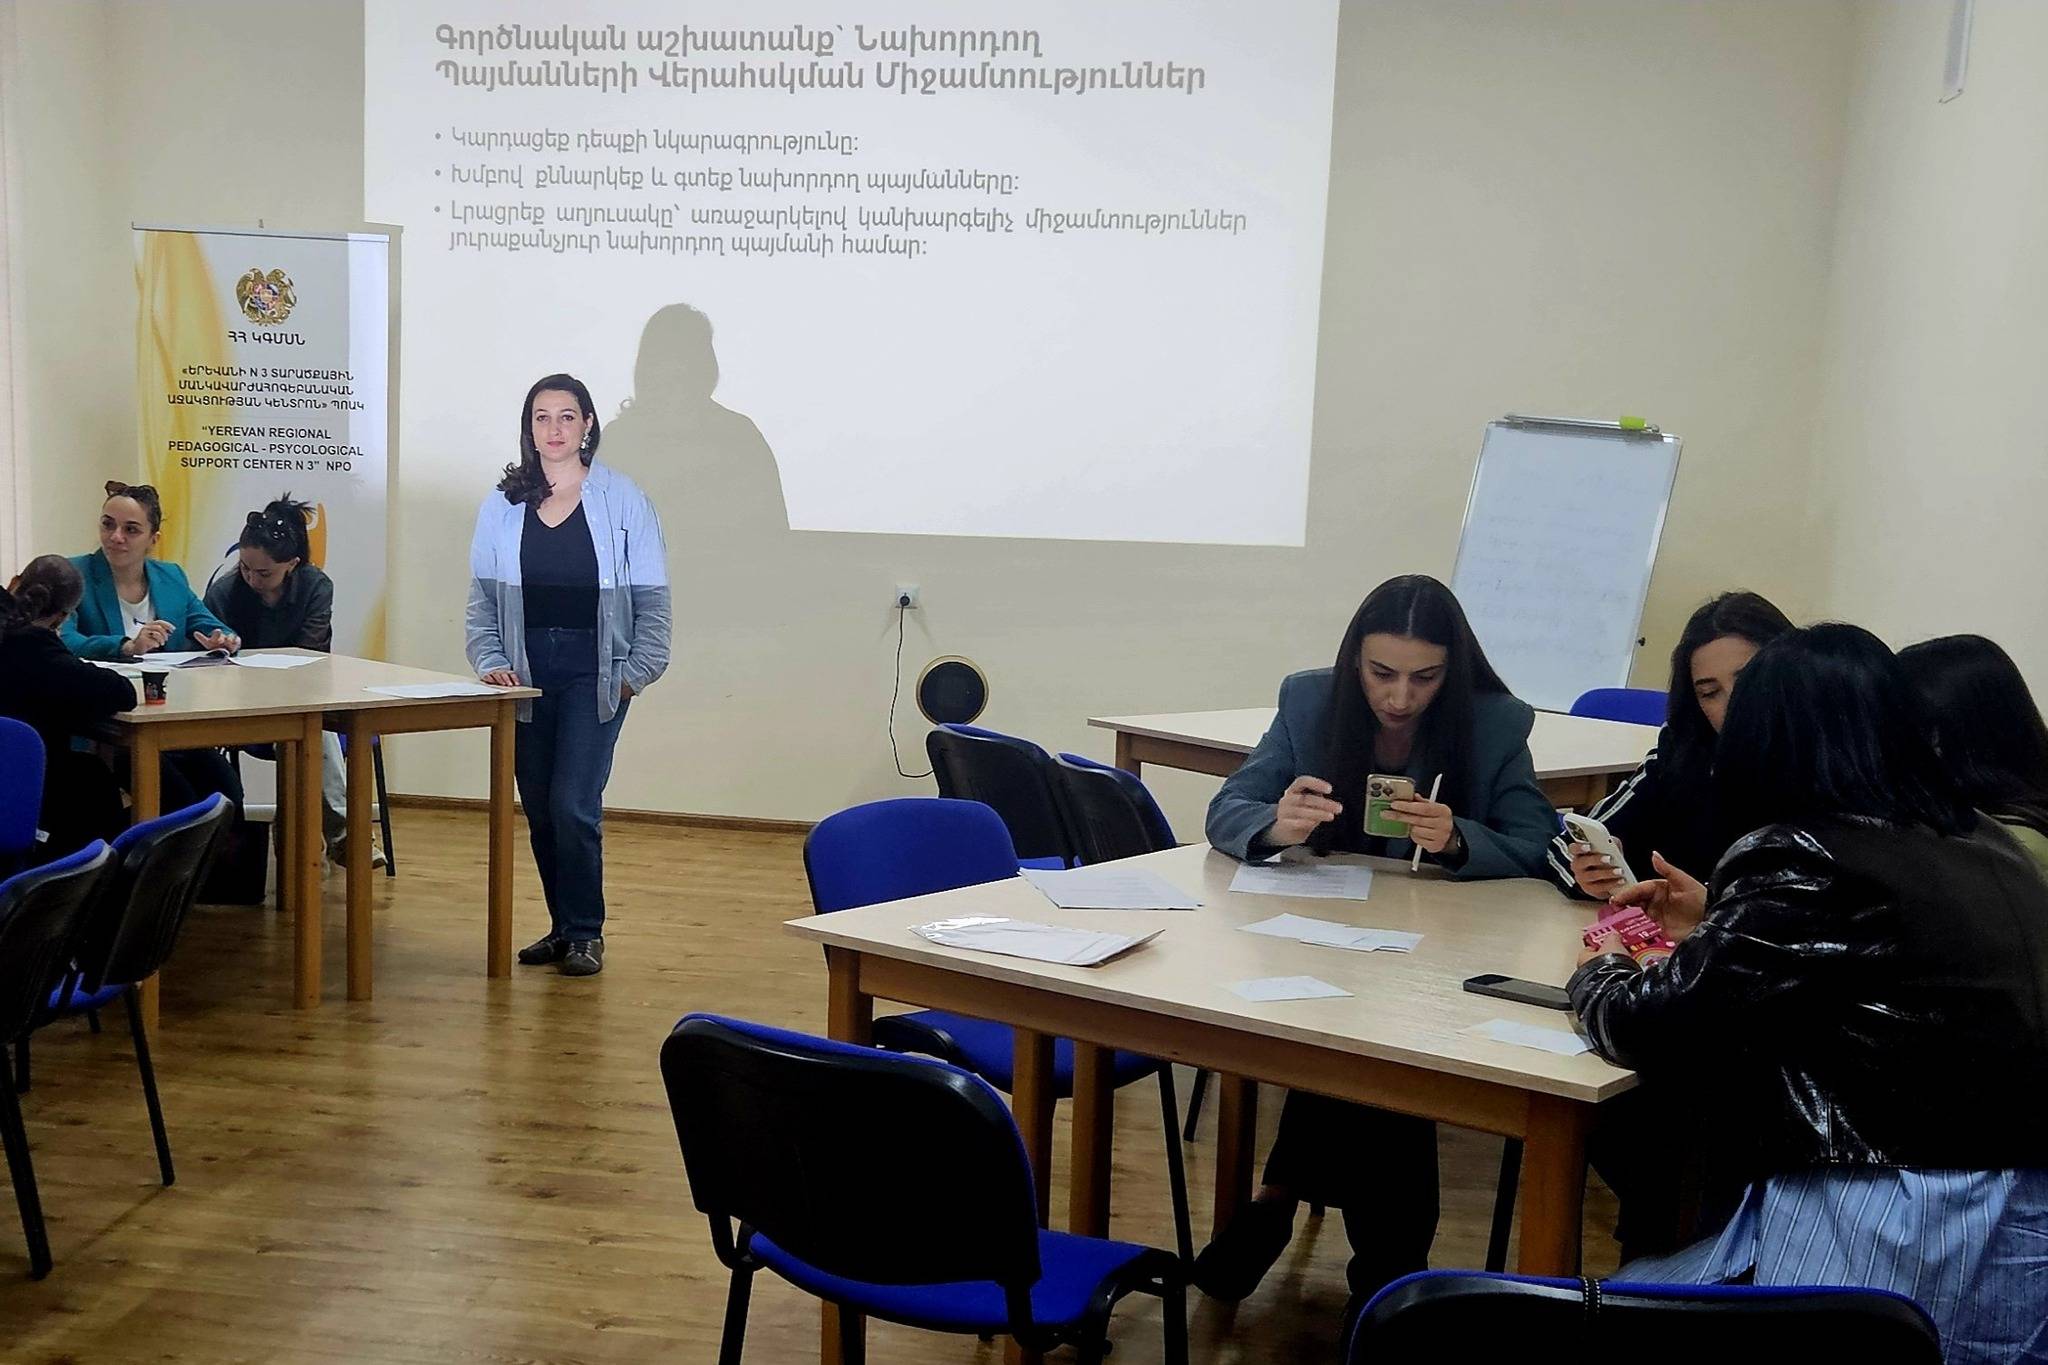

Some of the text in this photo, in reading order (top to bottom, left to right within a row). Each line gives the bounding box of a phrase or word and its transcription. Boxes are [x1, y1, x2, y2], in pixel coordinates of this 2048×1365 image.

[436, 24, 626, 56] Գործնական
[854, 25, 1043, 57] Նախորդող
[436, 60, 1206, 95] Պայմանների Վերահսկման Միջամտություններ
[452, 126, 570, 152] Կարդացեք
[577, 128, 648, 153] դեպքի
[451, 163, 524, 188] Խմբով
[535, 165, 644, 190] քննարկեք
[652, 166, 667, 186] և
[674, 167, 733, 191] գտեք
[739, 168, 861, 193] նախորդող
[451, 200, 545, 225] Լրացրեք
[691, 205, 847, 230] առաջարկելով
[859, 206, 1014, 232] կանխարգելիչ
[1026, 207, 1247, 235] միջամտություններ
[449, 229, 600, 253] յուրաքանչյուր
[607, 230, 725, 256] նախորդող
[731, 233, 833, 258] պայմանի
[228, 331, 306, 345] ՀՀ ԿԳՄՍՆ
[182, 365, 354, 381] «ԵՐԵՎԱՆԻ N 3 ՏԱՐԱԾՔԱՅԻՆ
[178, 380, 354, 395] ՄԱՆԿԱՎԱՐԺԱՀՈԳԵԲԱՆԱԿԱՆ
[168, 394, 364, 411] ԱՋԱԿՑՈՒԹՅԱՆ ԿԵՆՏՐՈՆ» ՊՈԱԿ
[269, 428, 331, 439] REGIONAL
[168, 441, 258, 453] PEDAGOGICAL
[269, 443, 364, 456] PSYCOLOGICAL
[180, 457, 240, 469] SUPPORT
[243, 459, 292, 470] CENTER
[296, 461, 303, 470] N
[326, 461, 351, 472] NPO
